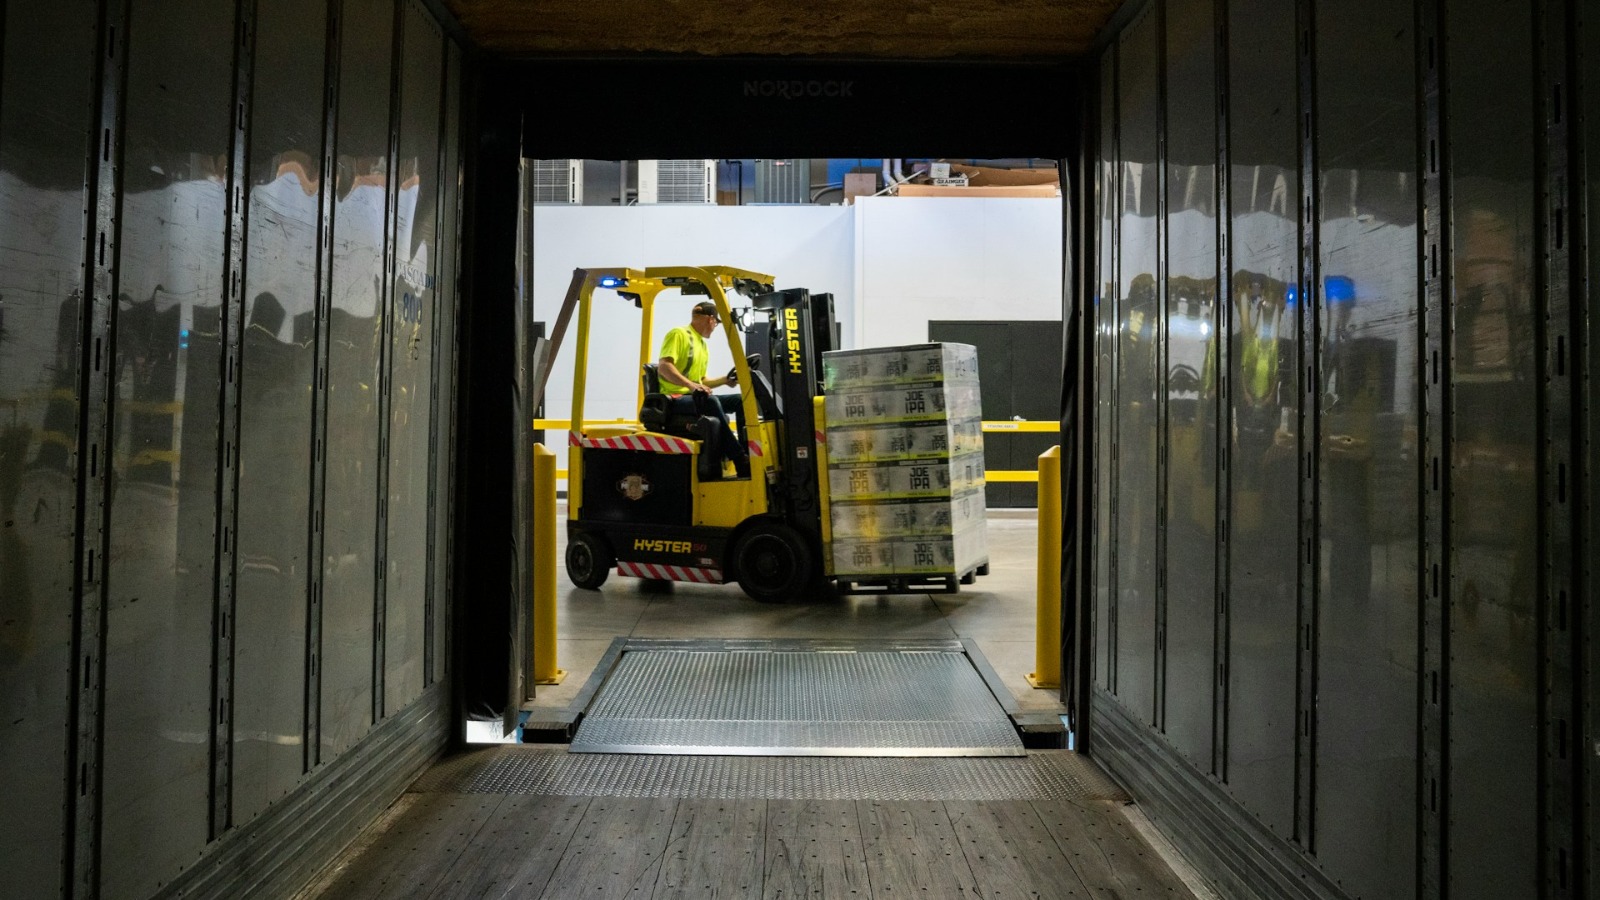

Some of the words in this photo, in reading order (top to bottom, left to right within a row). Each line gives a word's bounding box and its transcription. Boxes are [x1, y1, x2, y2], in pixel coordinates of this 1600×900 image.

[743, 80, 854, 100] NORDOCK
[403, 292, 422, 325] 800
[784, 307, 802, 374] HYSTER
[927, 358, 941, 366] JOE
[926, 366, 941, 374] IPA
[845, 394, 864, 405] JOE
[904, 390, 925, 401] JOE
[845, 405, 865, 418] IPA
[905, 401, 925, 414] IPA
[891, 444, 905, 452] IPA
[932, 442, 947, 451] IPA
[849, 469, 868, 480] JOE
[909, 466, 929, 477] JOE
[849, 480, 869, 493] IPA
[909, 477, 930, 490] IPA
[633, 538, 692, 554] HYSTER
[853, 544, 872, 554] JOE
[913, 543, 933, 553] JOE
[852, 555, 872, 566] IPA
[914, 553, 935, 566] IPA
